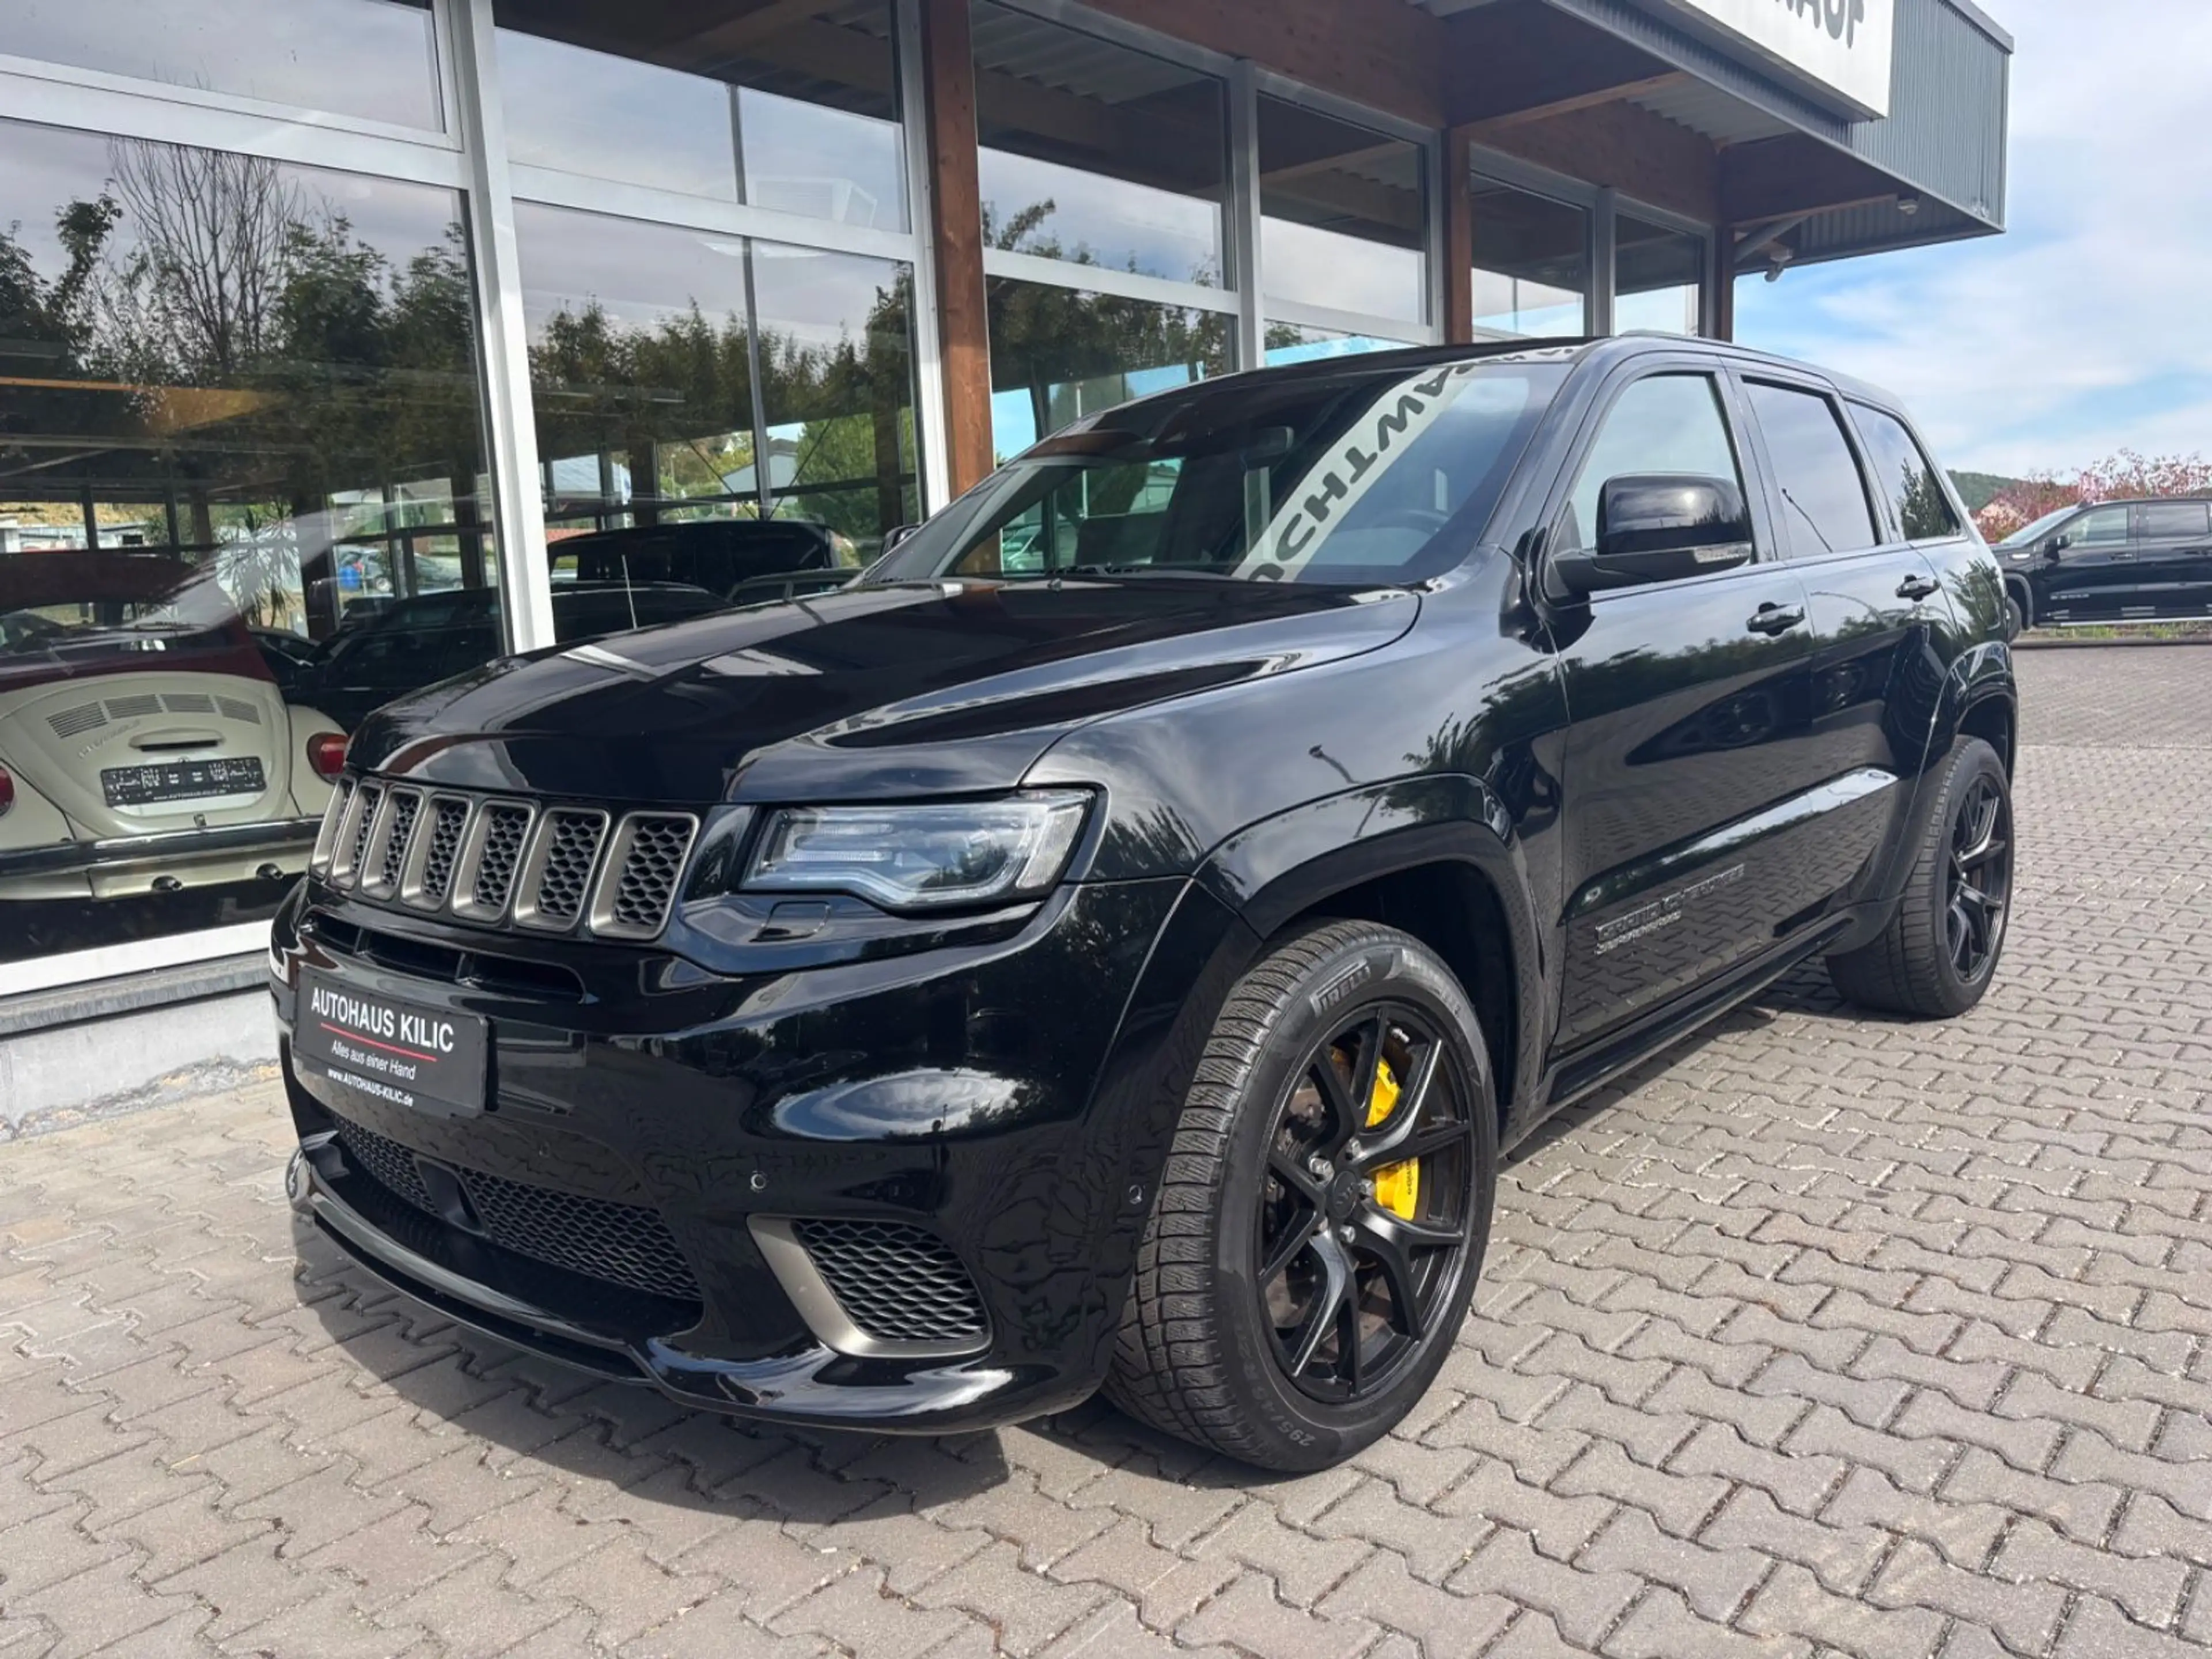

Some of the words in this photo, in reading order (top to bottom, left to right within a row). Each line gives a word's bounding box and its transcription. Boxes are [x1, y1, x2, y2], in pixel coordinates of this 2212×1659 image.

[311, 986, 395, 1038] AUTOHAUS
[400, 1013, 454, 1053] KILIC
[331, 1039, 349, 1059] Alles
[350, 1049, 365, 1065] aus
[365, 1053, 388, 1071] einer
[389, 1059, 416, 1081] Hand
